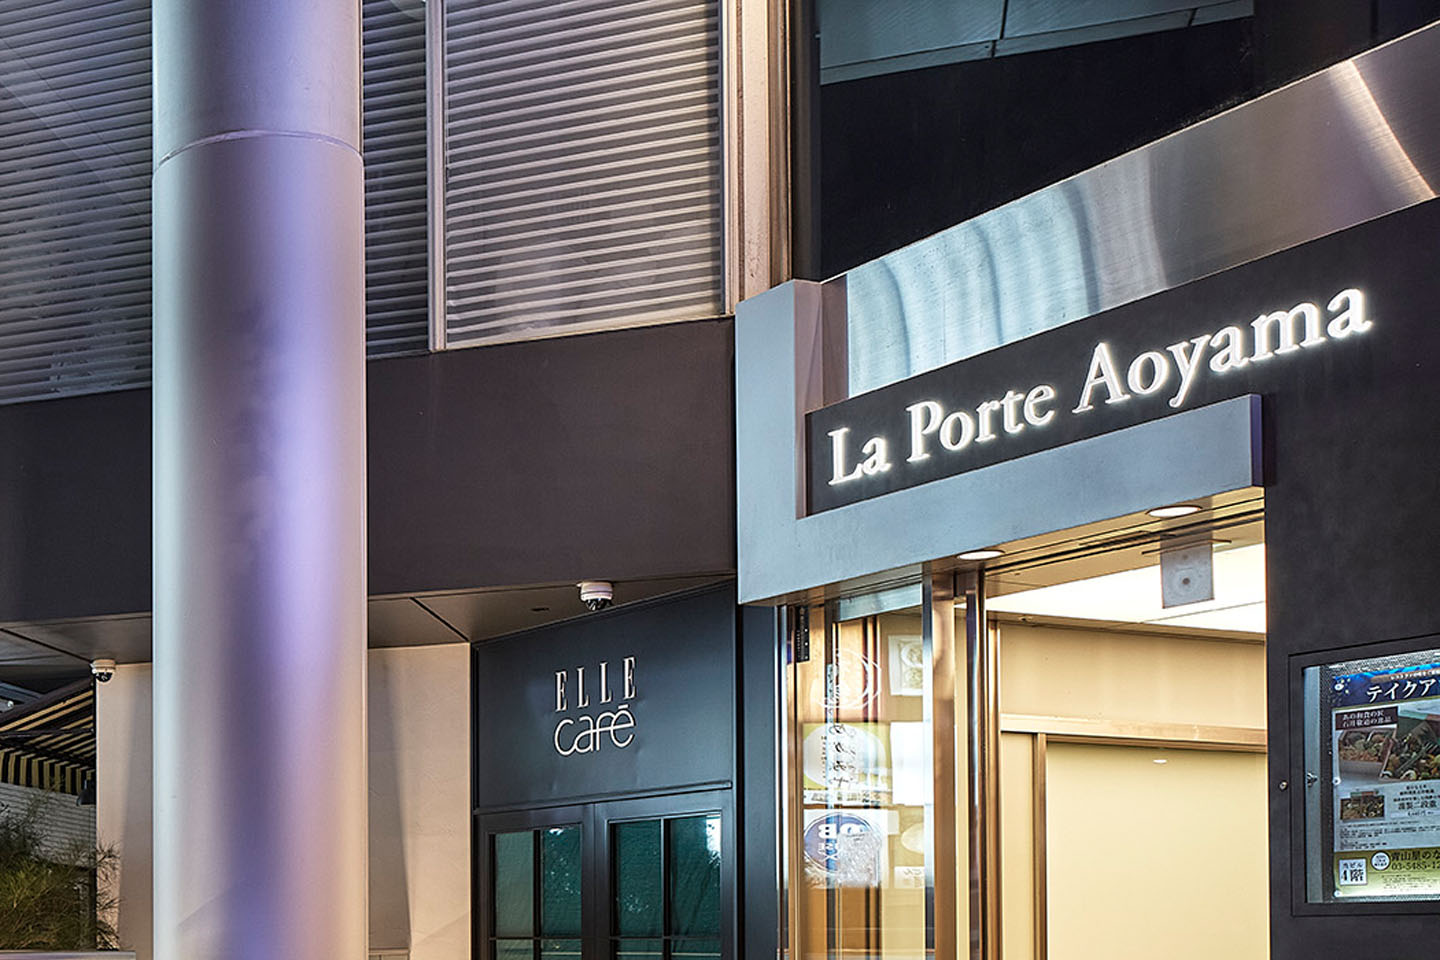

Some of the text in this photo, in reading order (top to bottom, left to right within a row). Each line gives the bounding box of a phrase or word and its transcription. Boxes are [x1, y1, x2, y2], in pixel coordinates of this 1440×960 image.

[827, 286, 1374, 487] La Porte Aoyama
[554, 656, 637, 712] ELLE
[1366, 678, 1440, 703] テイクア
[1391, 860, 1440, 872] 03-5485-12
